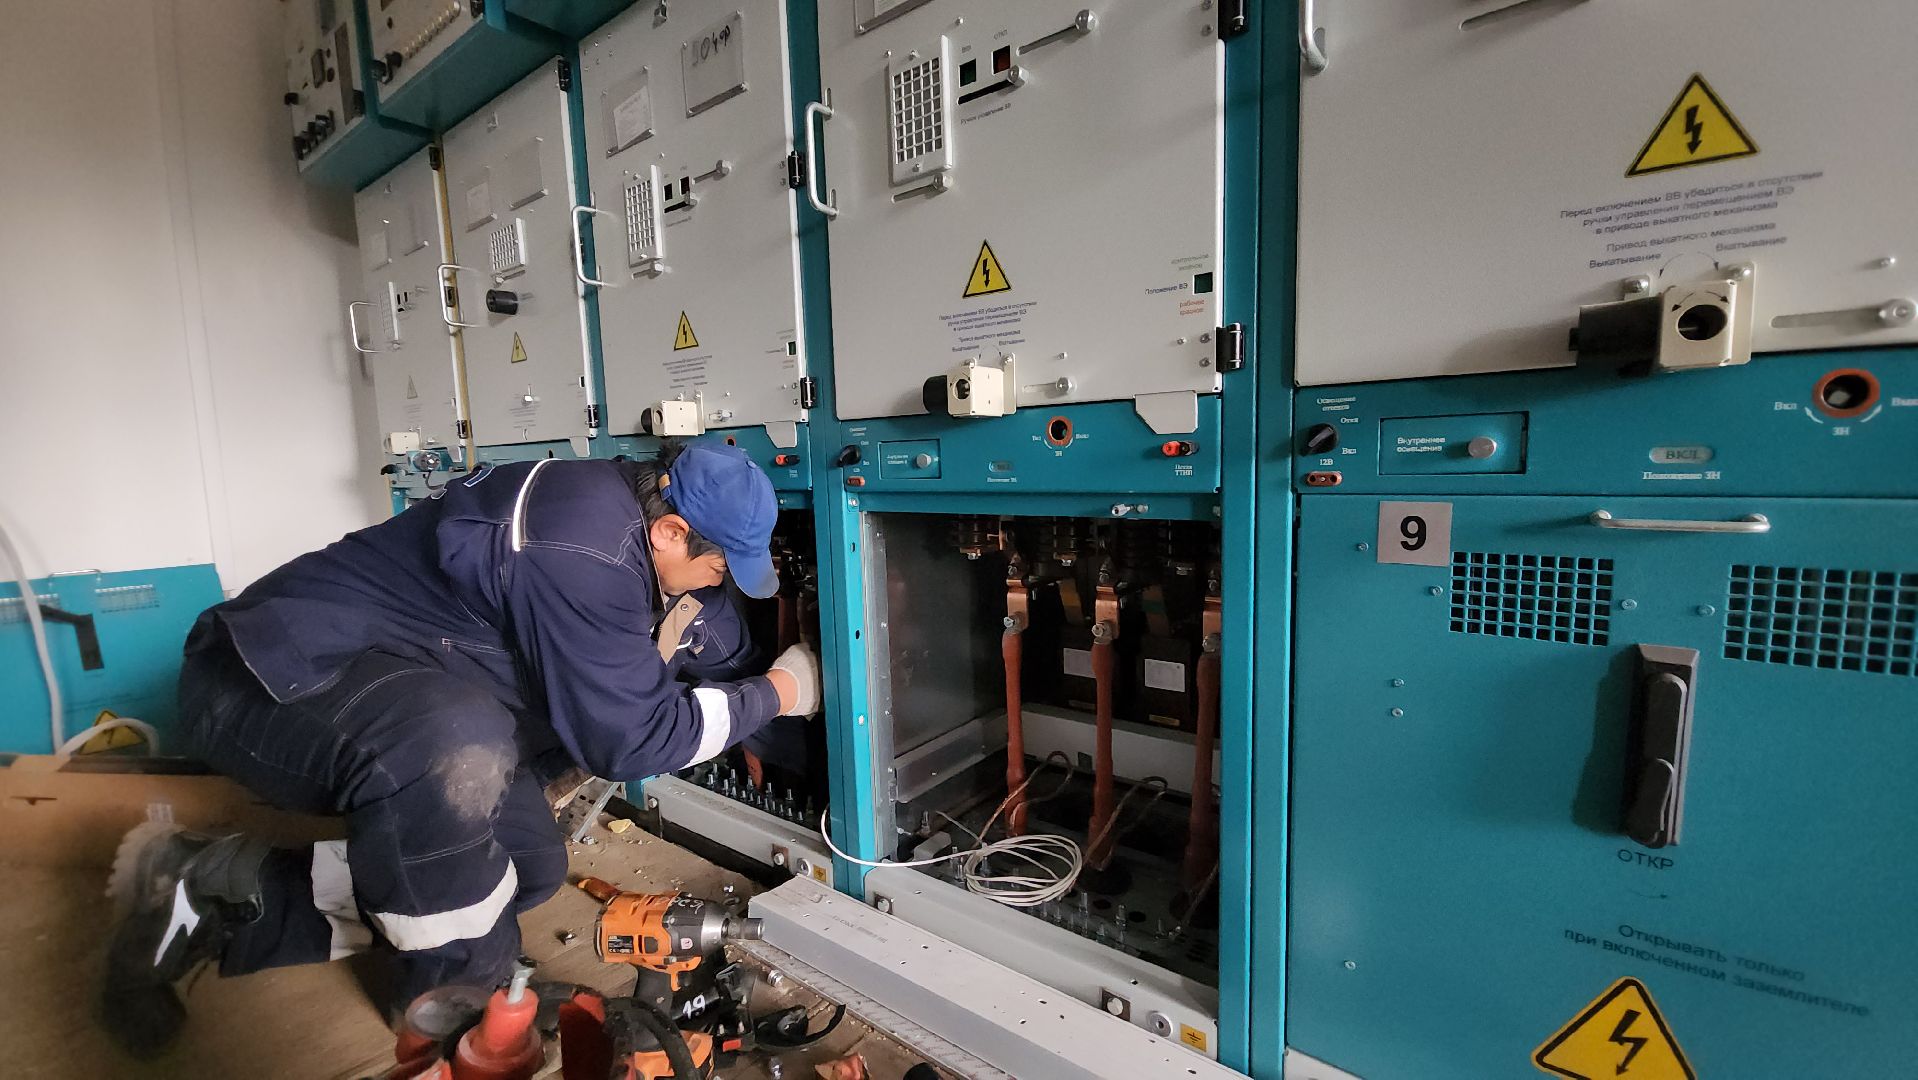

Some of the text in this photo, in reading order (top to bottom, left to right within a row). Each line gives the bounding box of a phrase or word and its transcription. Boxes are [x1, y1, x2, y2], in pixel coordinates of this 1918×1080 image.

[1560, 207, 1593, 219] Перед
[1595, 196, 1662, 213] включением
[1665, 191, 1681, 201] ВВ
[1684, 183, 1744, 199] убедиться
[1757, 171, 1824, 187] отсутствии
[1583, 215, 1613, 228] ручки
[1615, 205, 1680, 221] управления
[1683, 190, 1774, 210] перемещением
[1604, 220, 1650, 234] приводе
[1652, 211, 1711, 227] выкатного
[1712, 201, 1778, 217] механизма
[1606, 222, 1776, 252] Привод выкатного механизма
[1715, 236, 1788, 252] Вкатывание
[1589, 253, 1662, 269] Выкатывание
[1399, 515, 1428, 552] 9
[1616, 848, 1675, 871] ОТКР
[1617, 923, 1807, 983] Открывать только
[1563, 928, 1871, 1018] при включенном заземлителе
[682, 993, 706, 1020] 19
